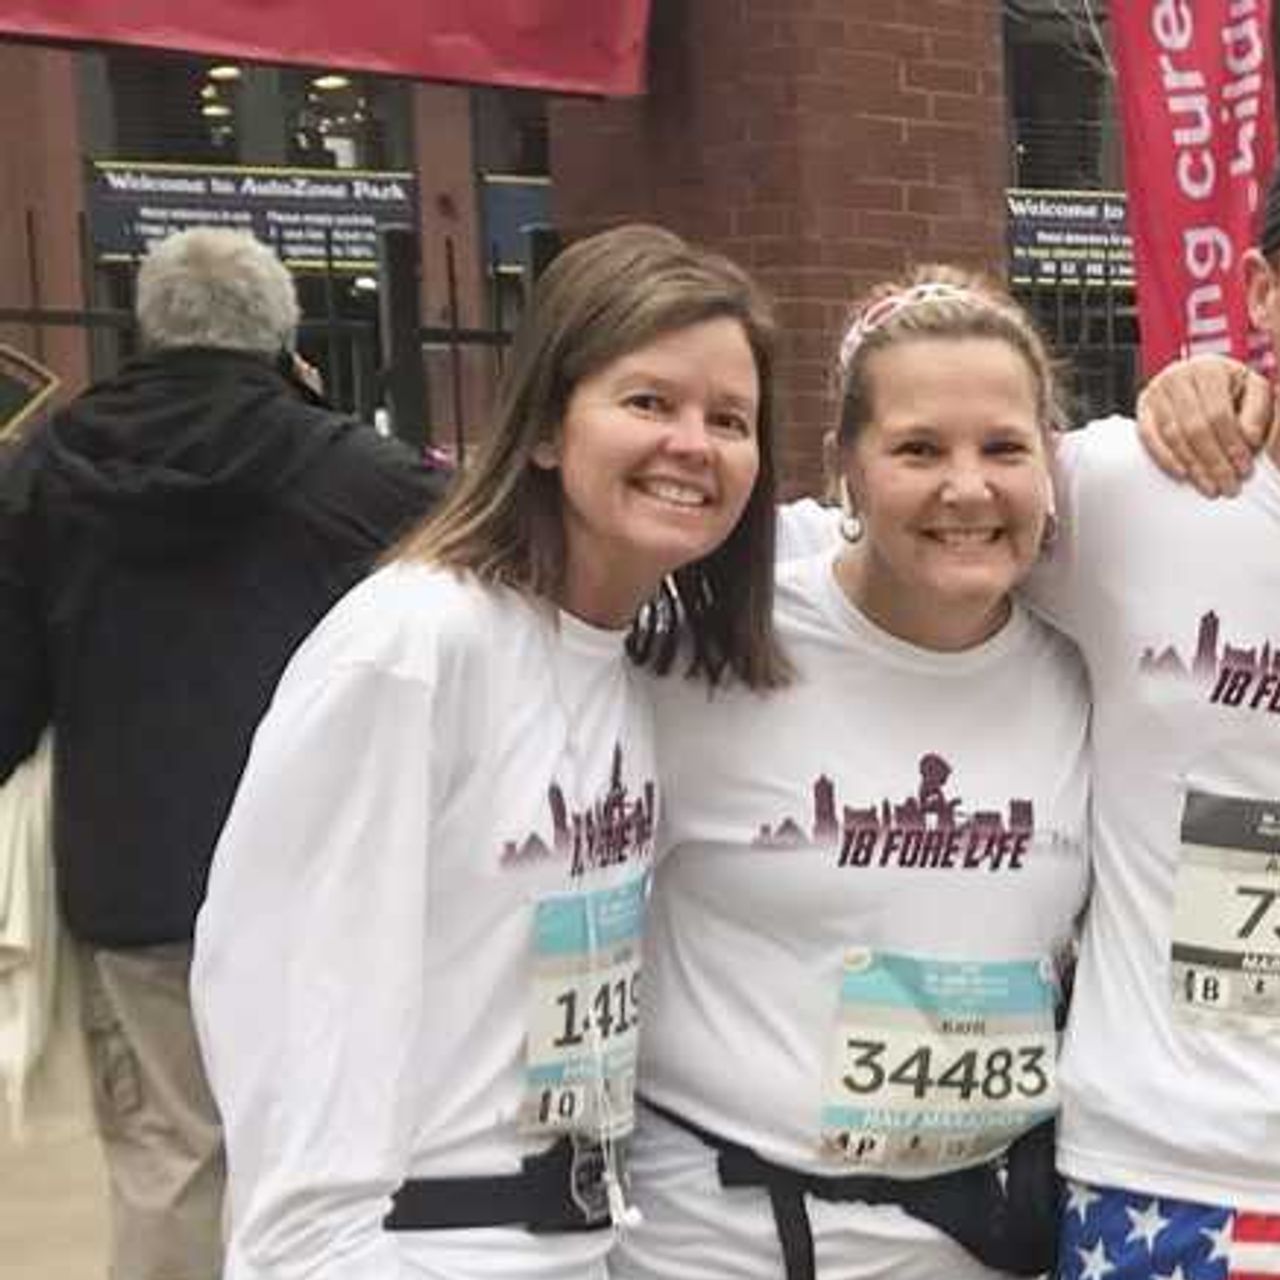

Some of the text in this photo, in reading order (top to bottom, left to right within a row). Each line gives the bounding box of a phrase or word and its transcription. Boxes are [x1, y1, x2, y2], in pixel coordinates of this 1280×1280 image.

[103, 172, 405, 200] Welcome to AutoZone Park
[1007, 197, 1124, 220] Welcome to
[843, 1037, 1049, 1100] 34483
